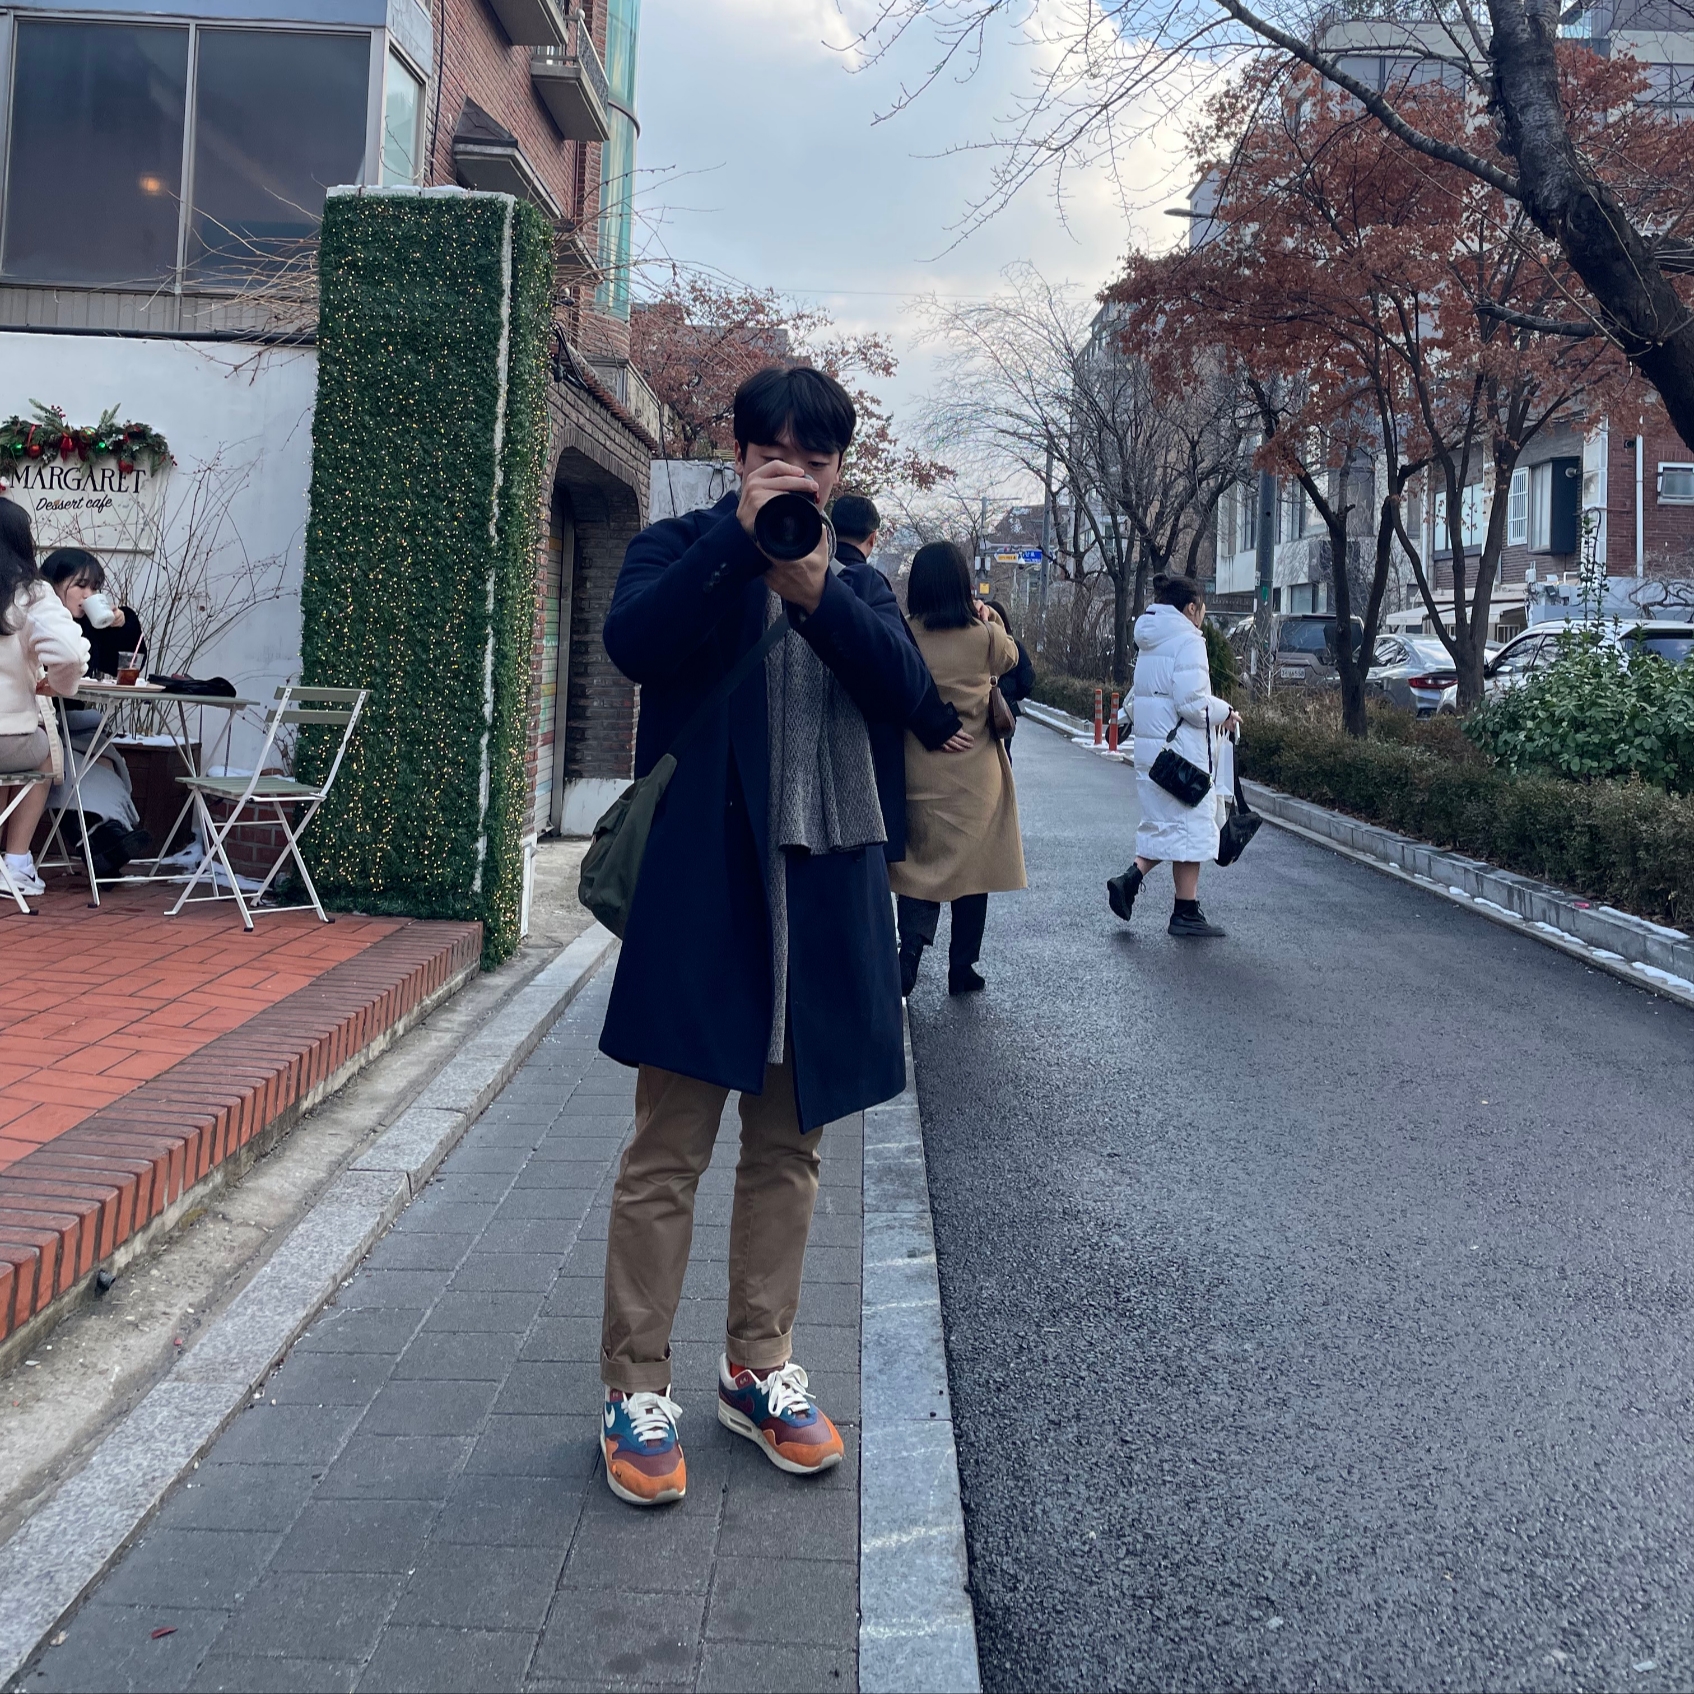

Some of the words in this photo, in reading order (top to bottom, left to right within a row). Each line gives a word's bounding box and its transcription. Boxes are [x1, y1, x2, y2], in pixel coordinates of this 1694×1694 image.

[10, 465, 147, 494] MARGARET
[36, 496, 84, 511] Dessert
[86, 494, 113, 513] cafe
